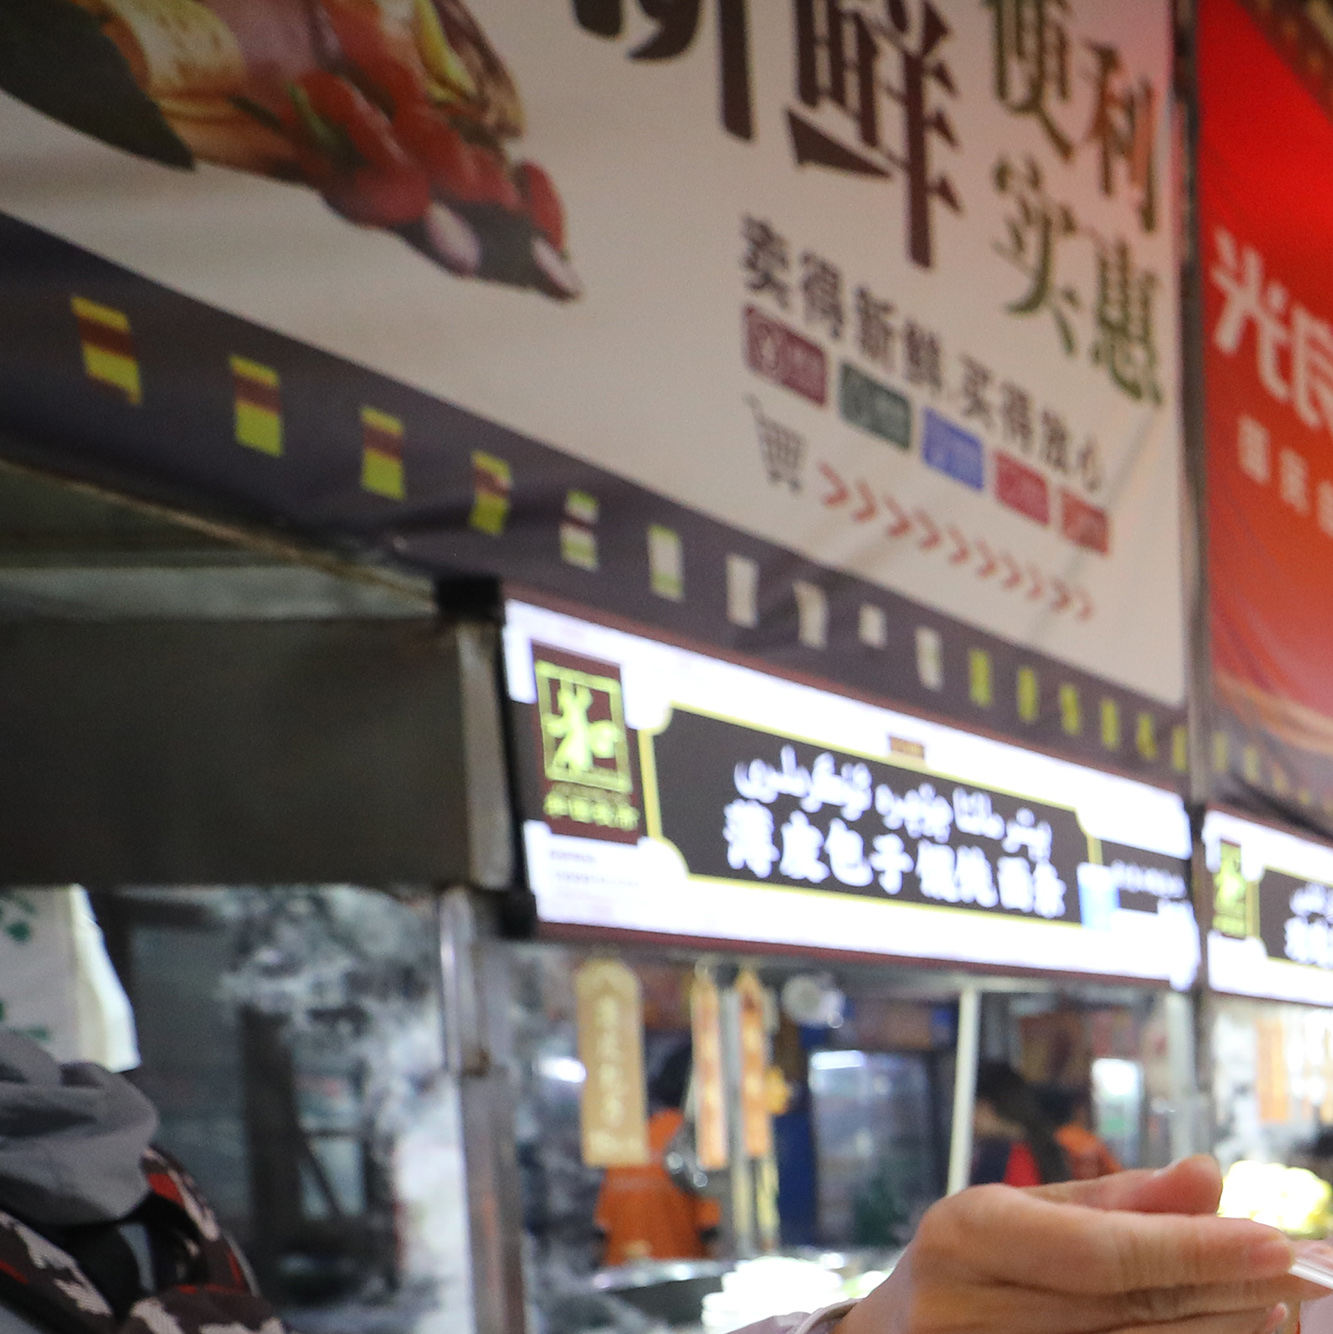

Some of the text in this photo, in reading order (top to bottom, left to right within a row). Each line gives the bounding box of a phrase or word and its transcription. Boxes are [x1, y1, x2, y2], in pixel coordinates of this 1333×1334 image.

[740, 211, 944, 397] 卖得新鲜
[959, 352, 1104, 493] 买得放心
[992, 153, 1163, 407] 实惠
